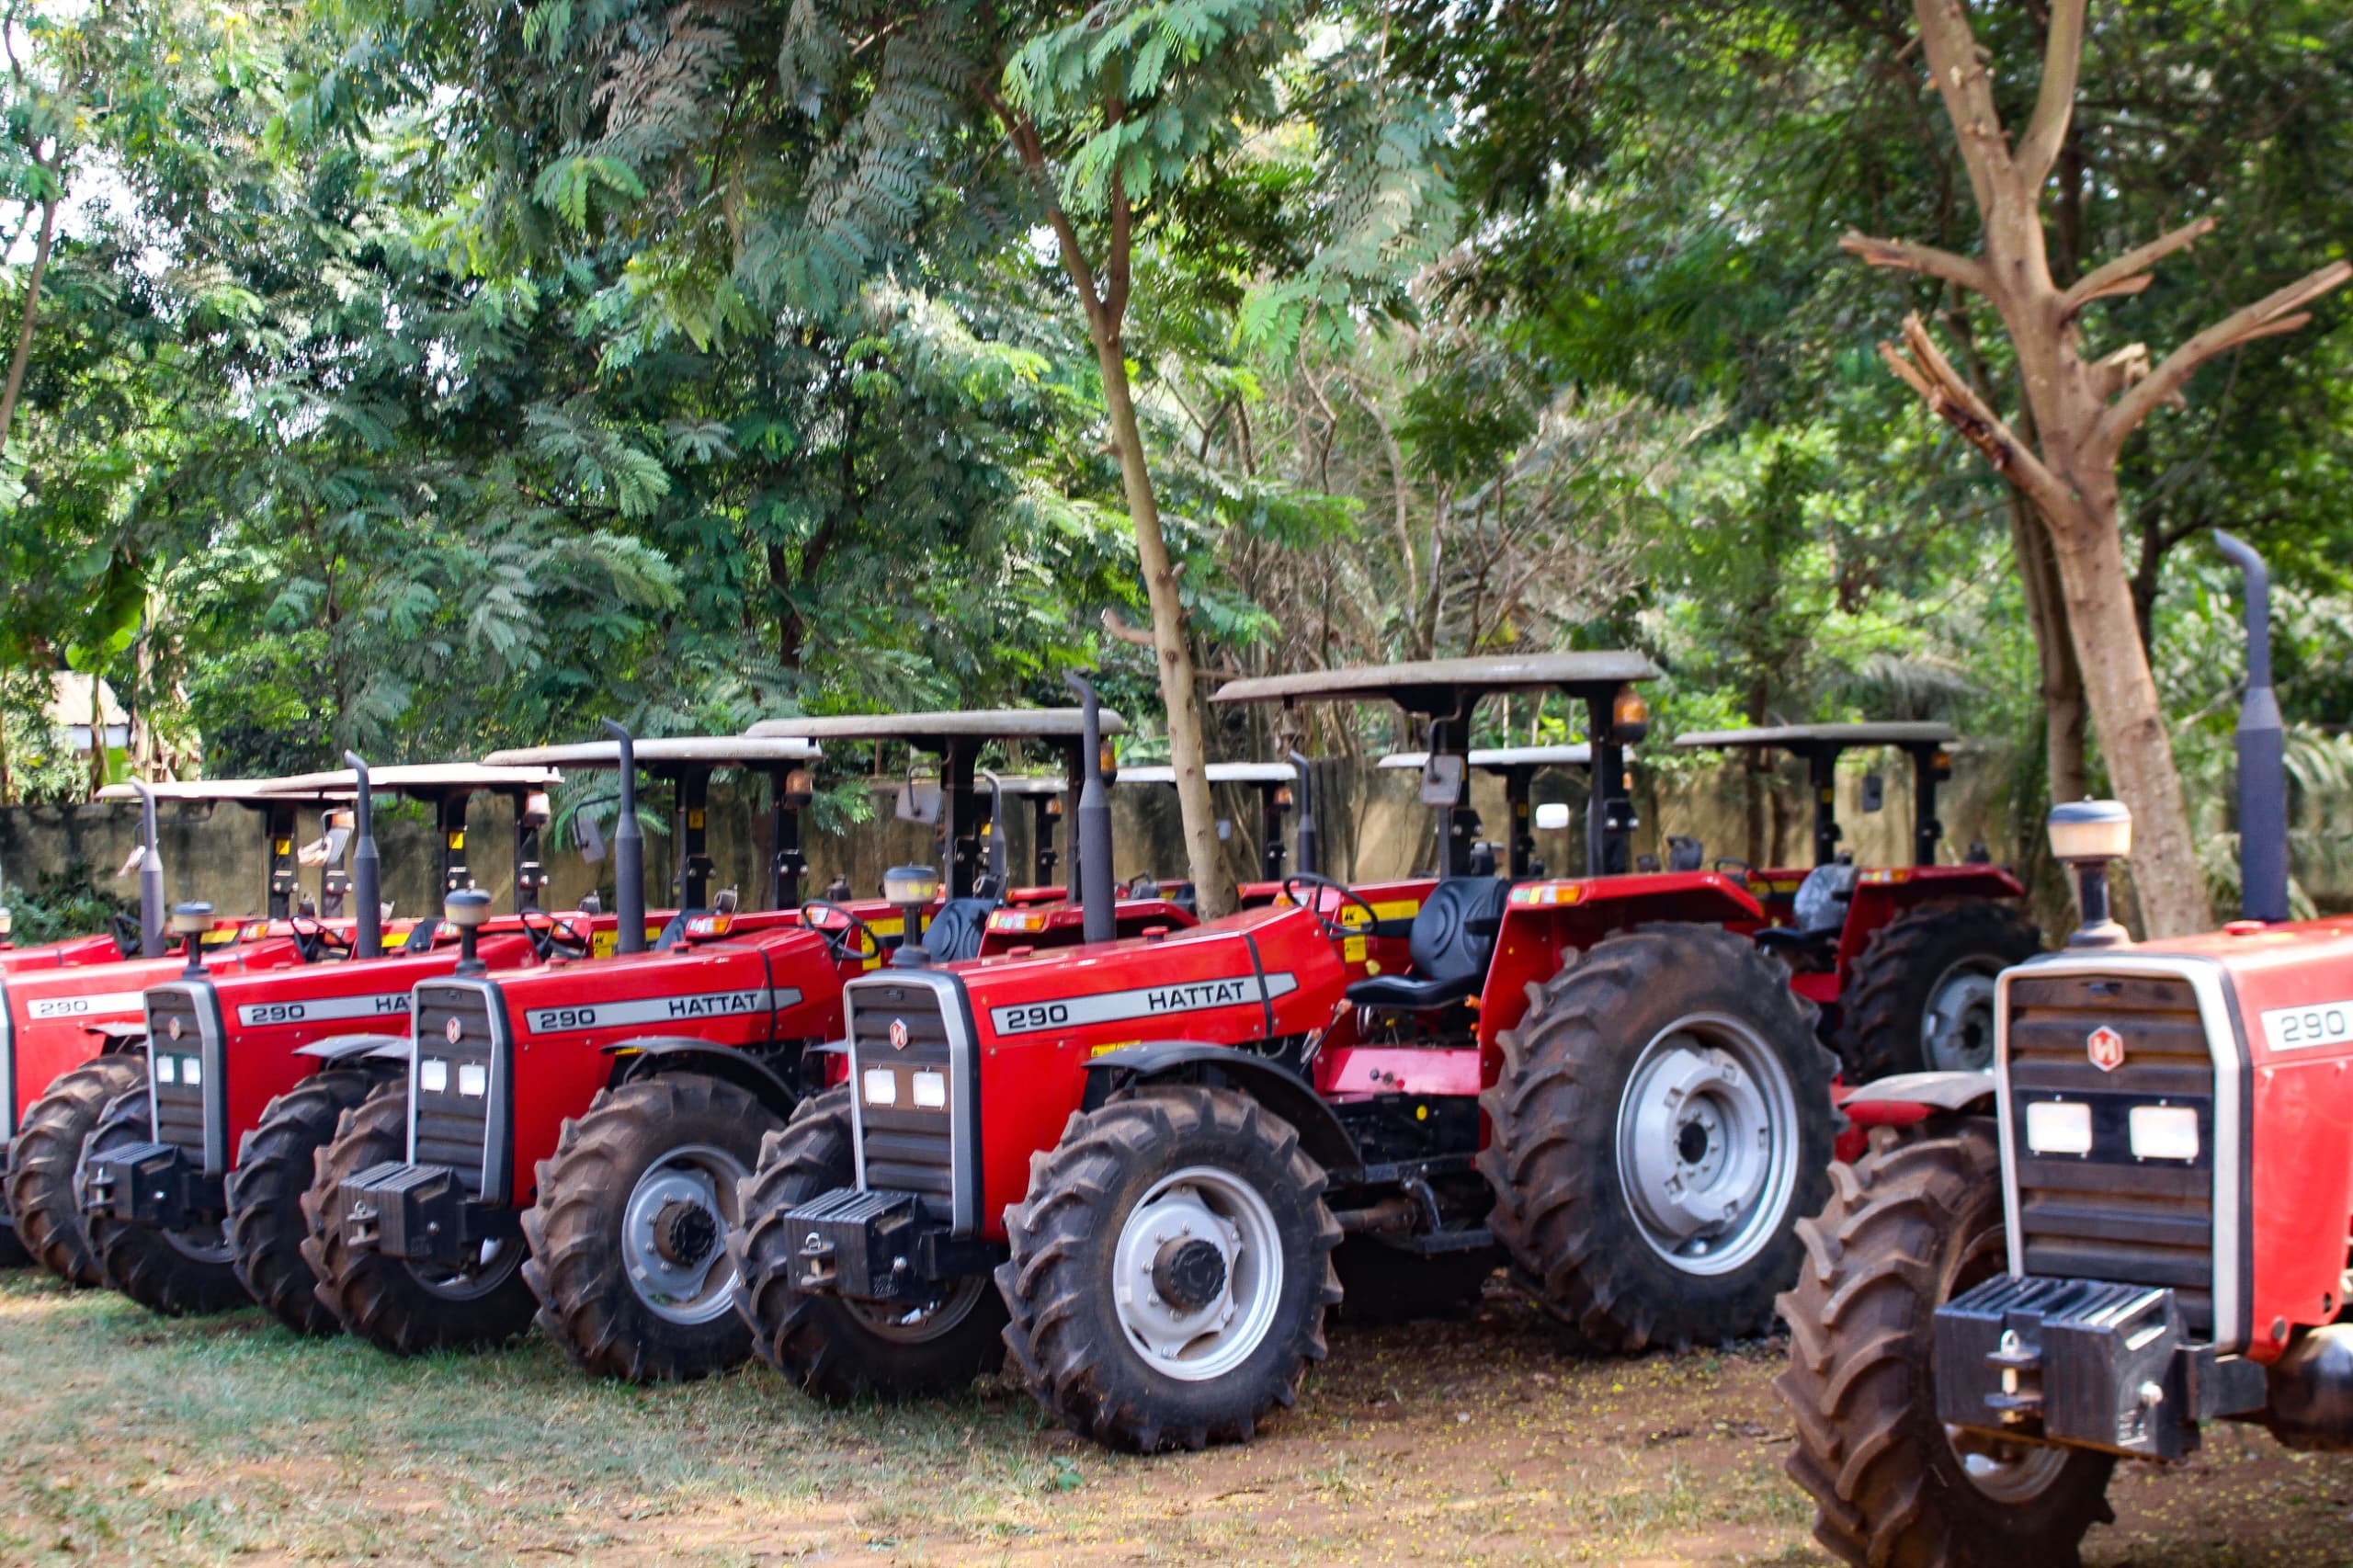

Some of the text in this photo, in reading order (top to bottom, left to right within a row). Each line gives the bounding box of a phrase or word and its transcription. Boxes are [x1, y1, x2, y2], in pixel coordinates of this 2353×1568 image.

[40, 1000, 88, 1016] 290
[251, 996, 413, 1023] 290 HA
[540, 993, 757, 1029] 290 HATTAT
[1006, 981, 1245, 1029] 290 HATTAT
[2281, 1010, 2345, 1041] 290
